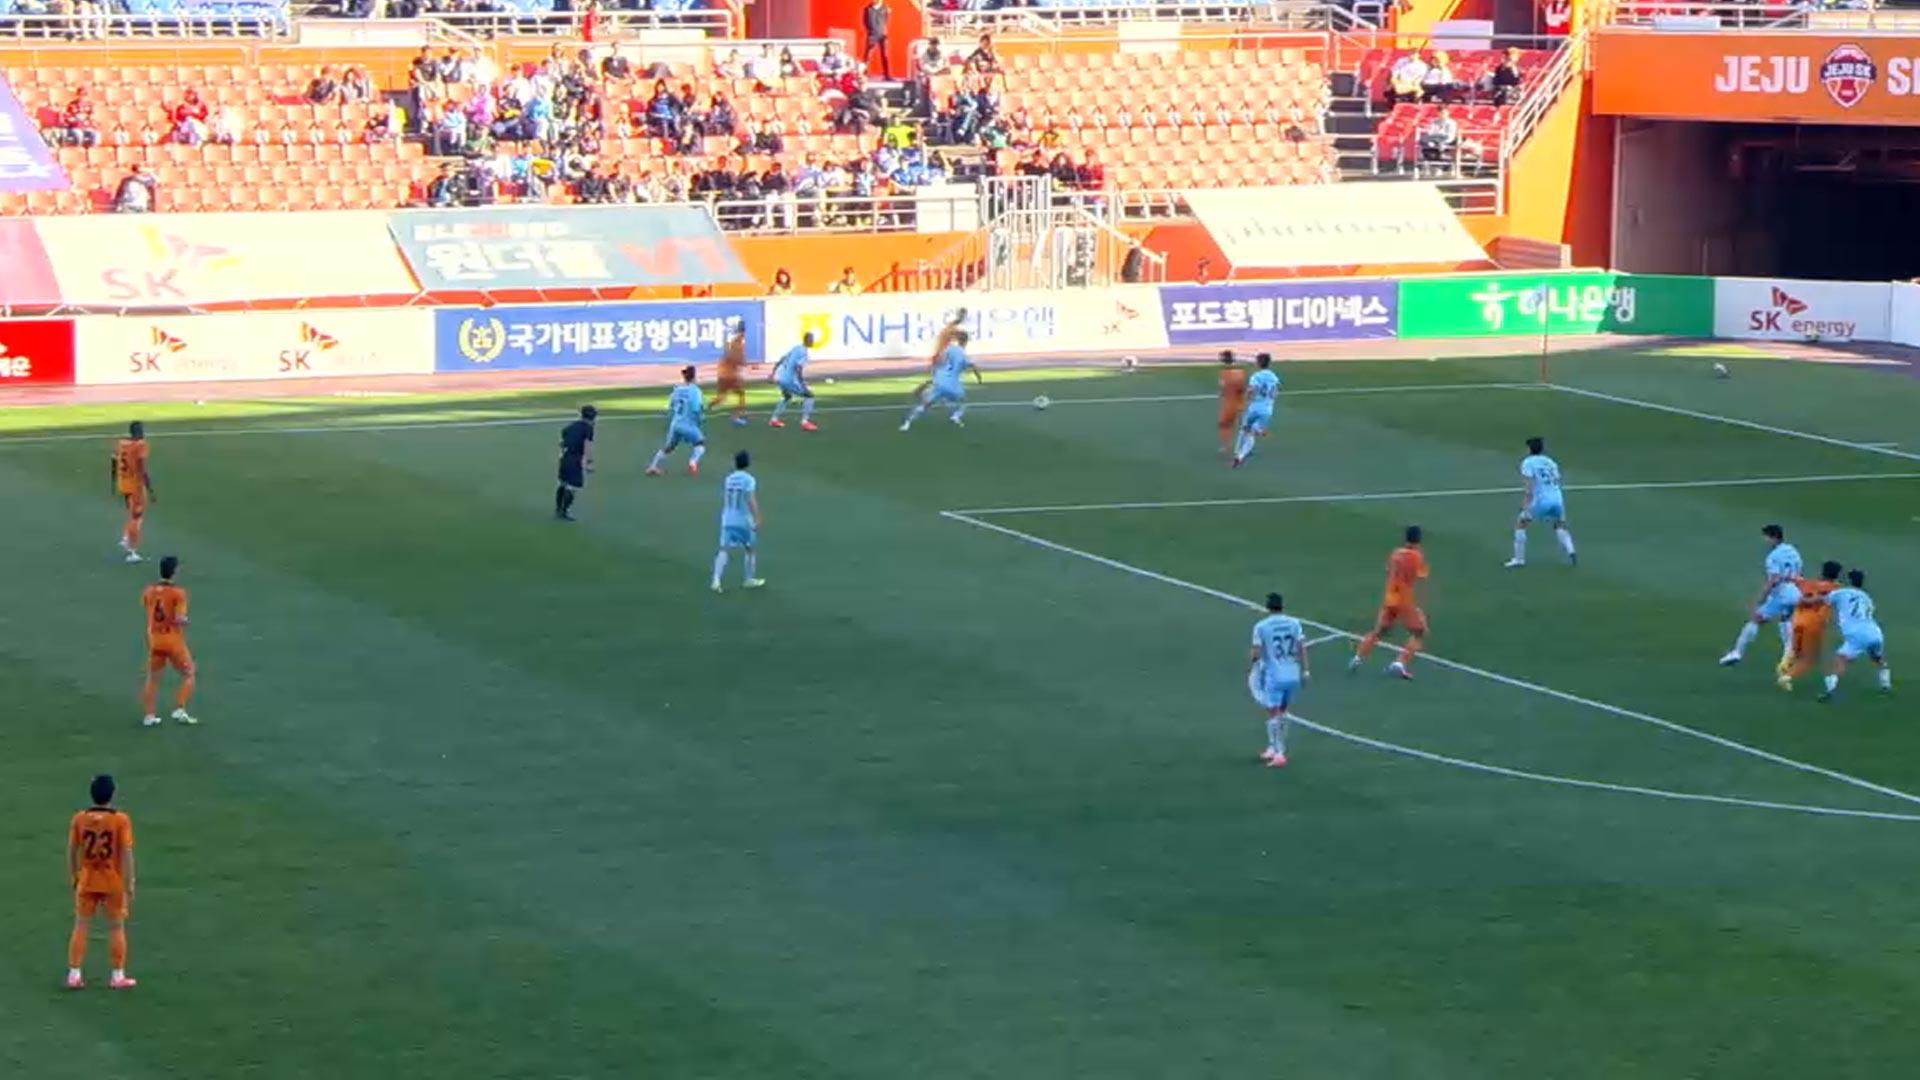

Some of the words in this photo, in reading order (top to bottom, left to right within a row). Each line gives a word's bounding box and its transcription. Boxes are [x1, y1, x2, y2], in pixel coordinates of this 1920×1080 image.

[1714, 55, 1810, 93] JEJU
[1823, 63, 1855, 78] JEJU
[100, 267, 186, 300] SK
[1748, 311, 1781, 332] SK
[1791, 318, 1857, 338] energy
[128, 352, 162, 373] SK
[277, 350, 312, 372] SK
[1272, 634, 1297, 660] 32
[82, 830, 114, 861] 23
